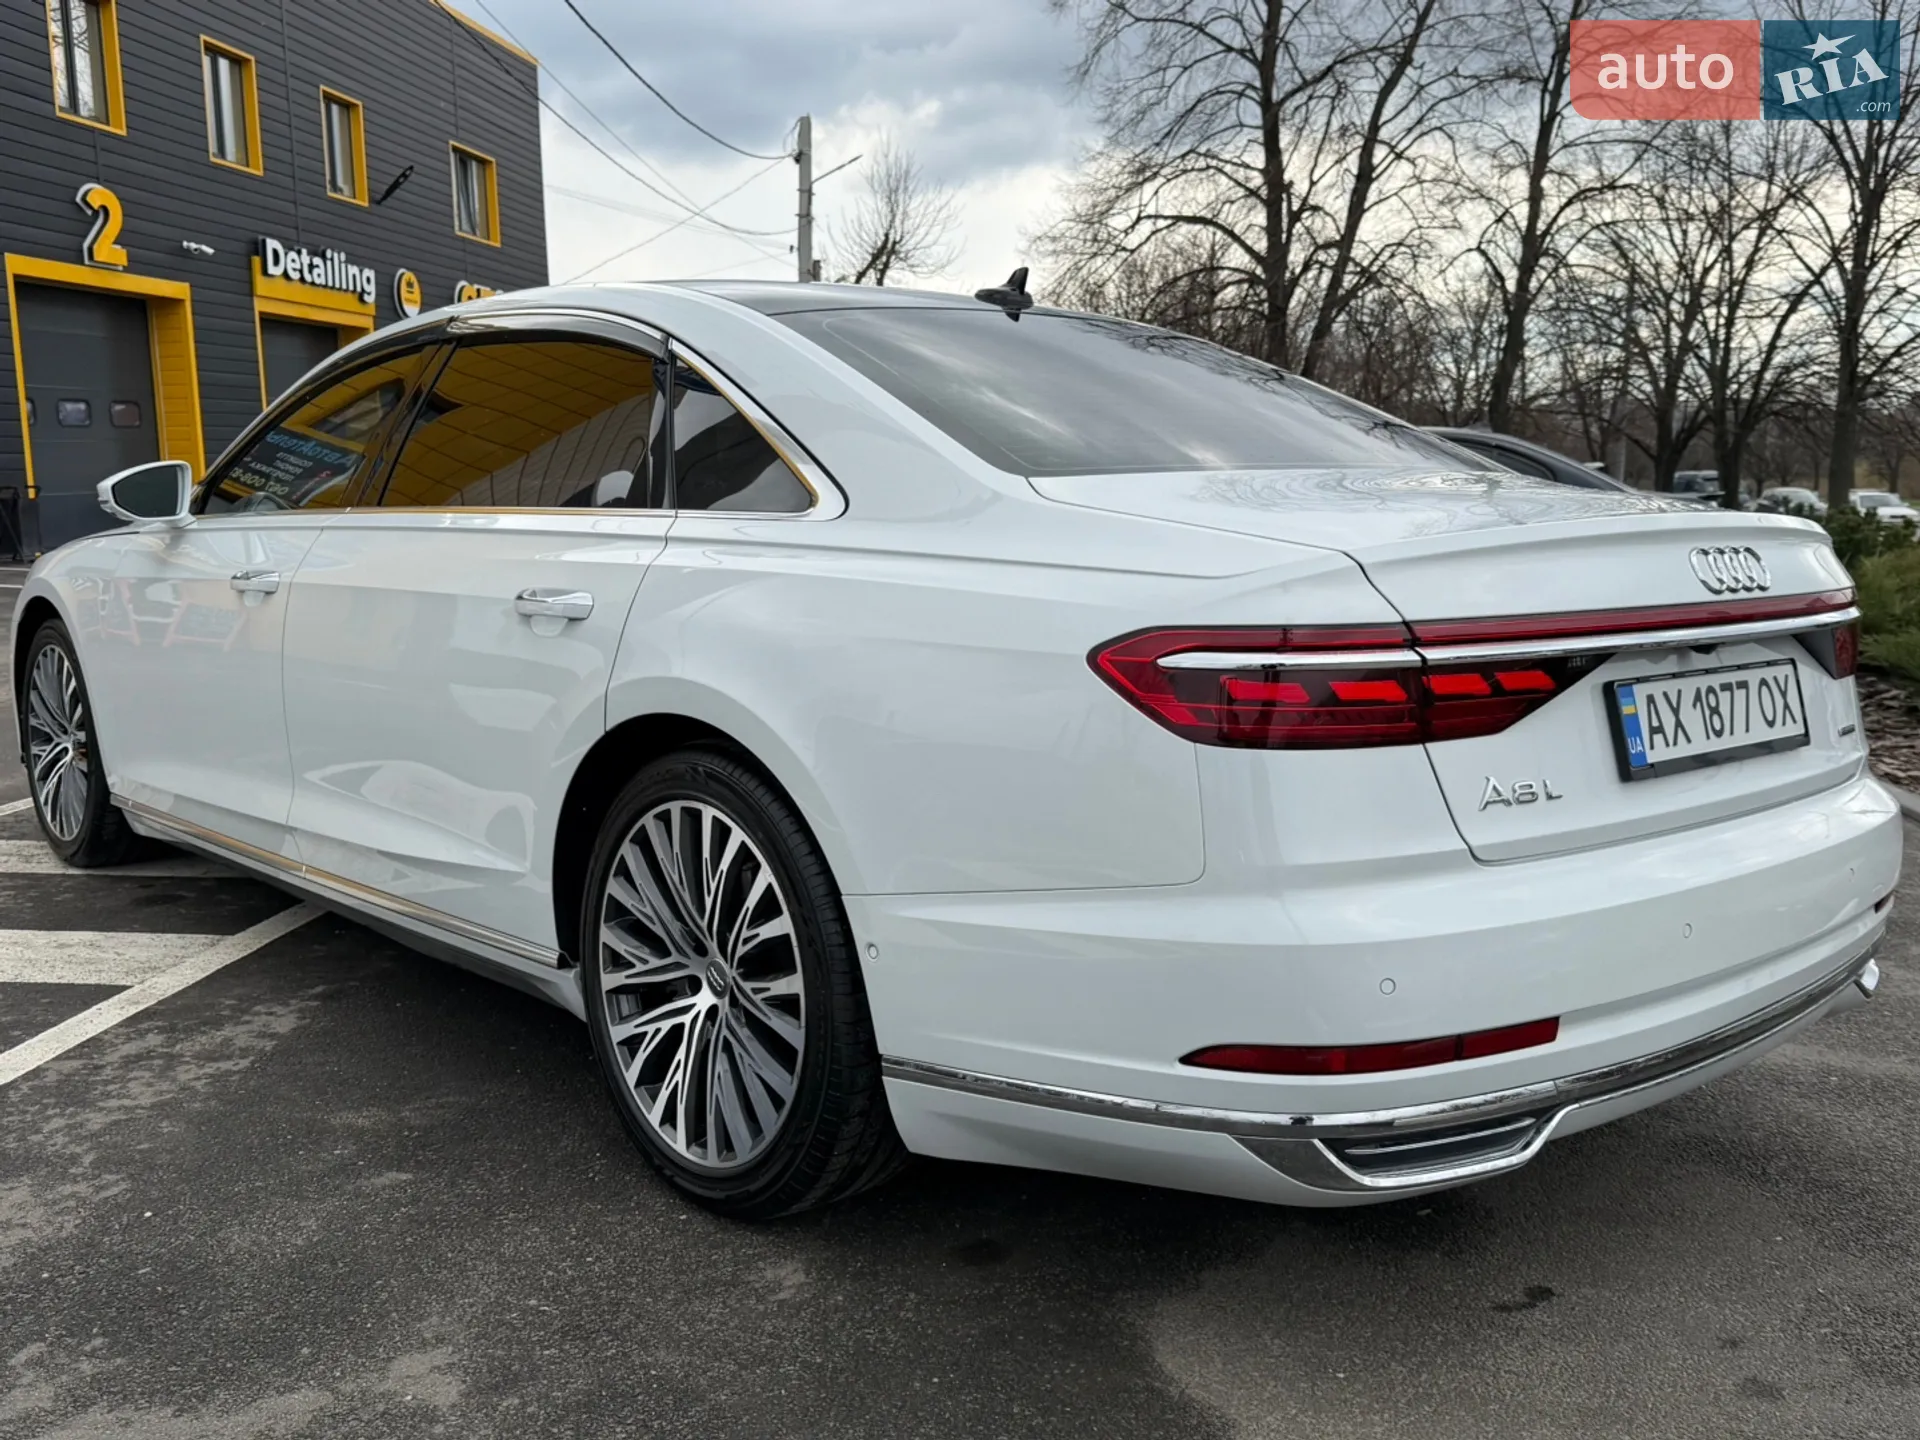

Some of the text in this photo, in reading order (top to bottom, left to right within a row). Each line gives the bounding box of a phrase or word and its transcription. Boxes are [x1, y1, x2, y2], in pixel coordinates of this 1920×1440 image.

[76, 183, 128, 271] 2
[264, 237, 376, 304] Detailing
[1628, 737, 1644, 754] UA
[1646, 674, 1798, 750] AX 1877 OX
